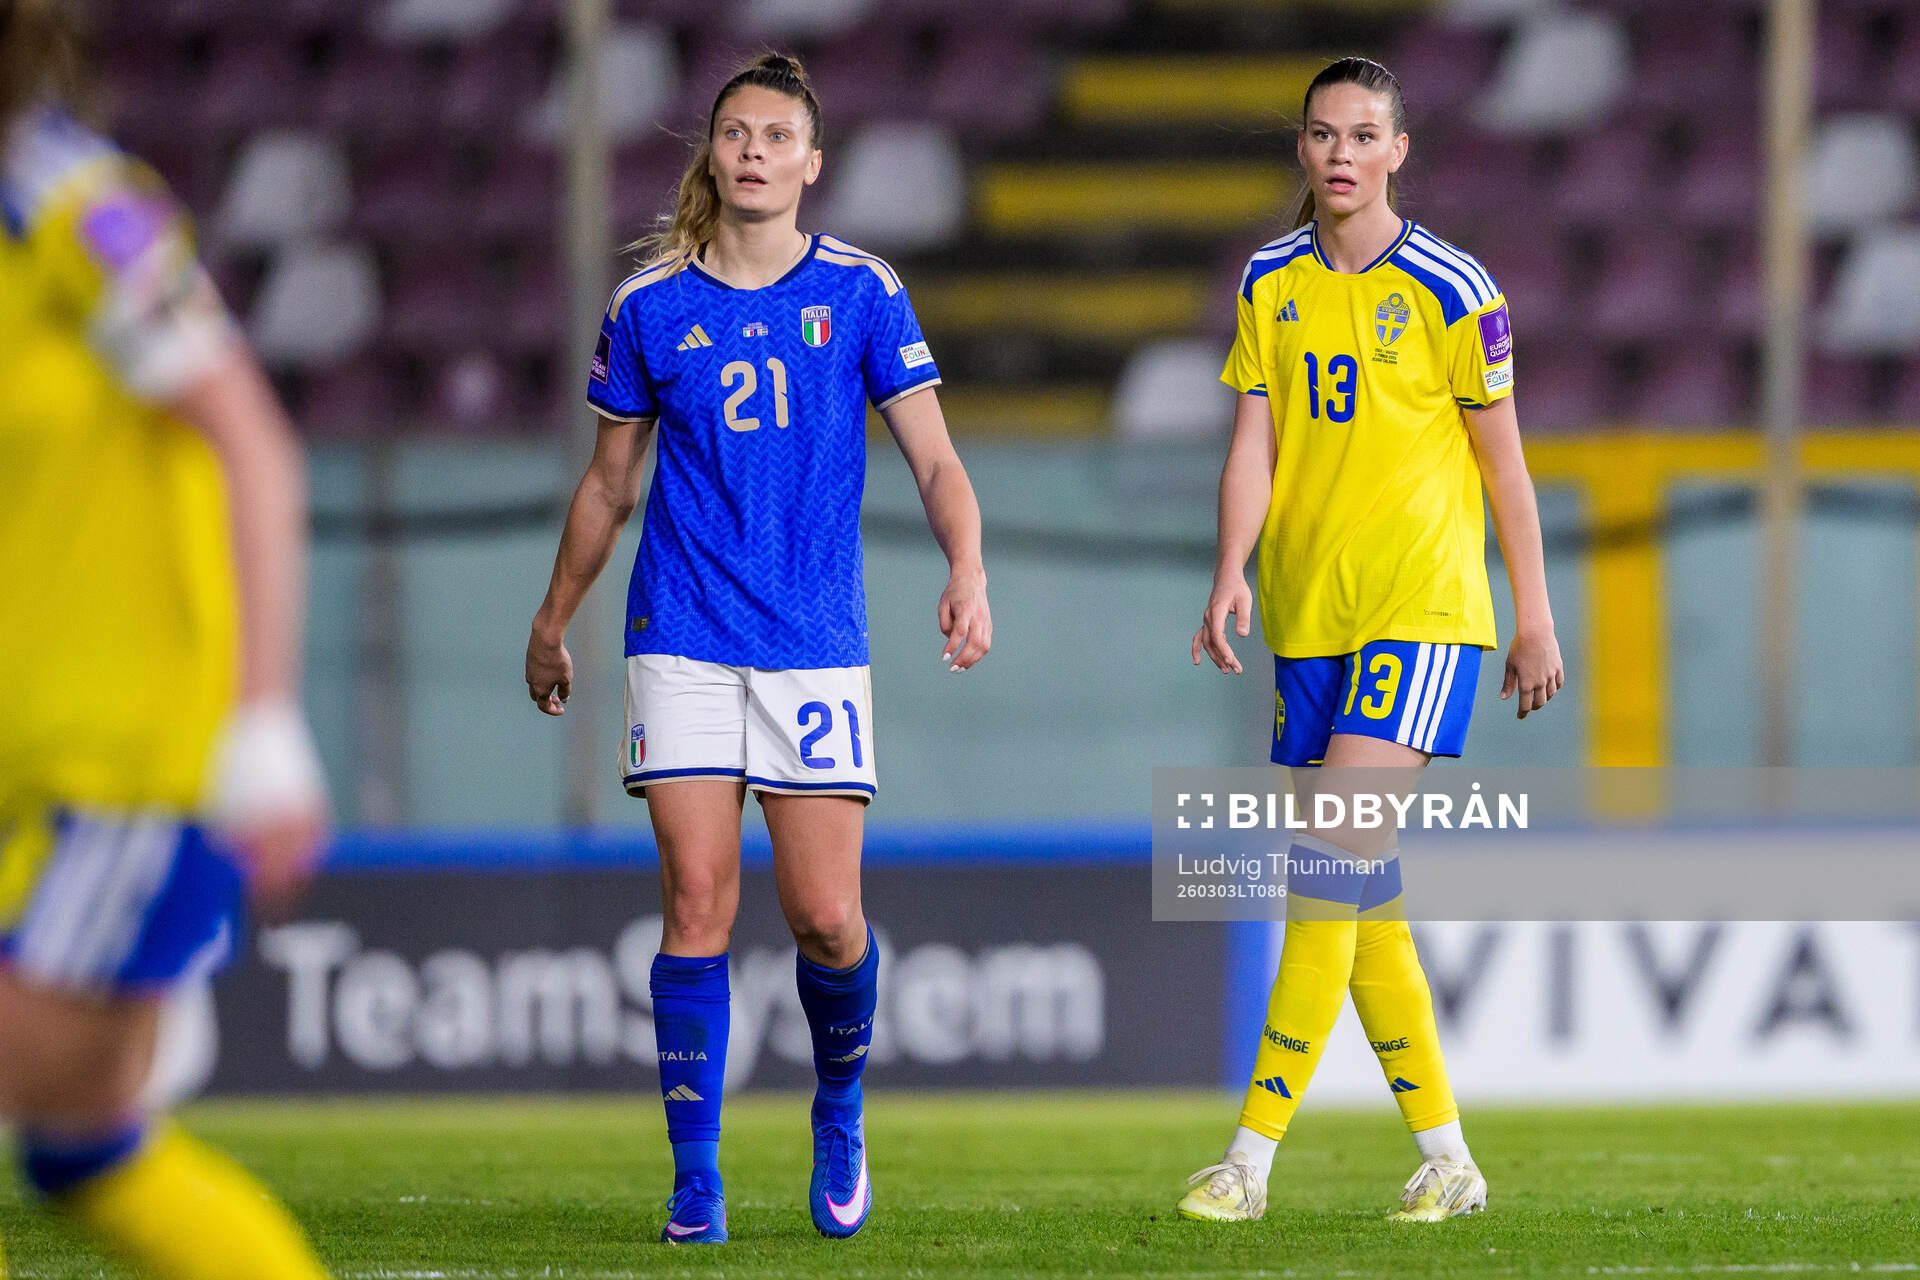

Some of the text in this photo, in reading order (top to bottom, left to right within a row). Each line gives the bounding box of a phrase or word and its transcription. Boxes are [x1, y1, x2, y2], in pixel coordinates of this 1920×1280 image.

[804, 309, 829, 319] ITALIA
[720, 357, 789, 432] 21
[1303, 351, 1358, 423] 13
[1344, 651, 1403, 720] 13
[797, 699, 863, 770] 21
[257, 913, 1107, 1090] TeamSysem
[829, 1016, 873, 1035] ITALI
[1264, 1024, 1311, 1054] SVERIGE
[1369, 1036, 1411, 1053] ERIGE
